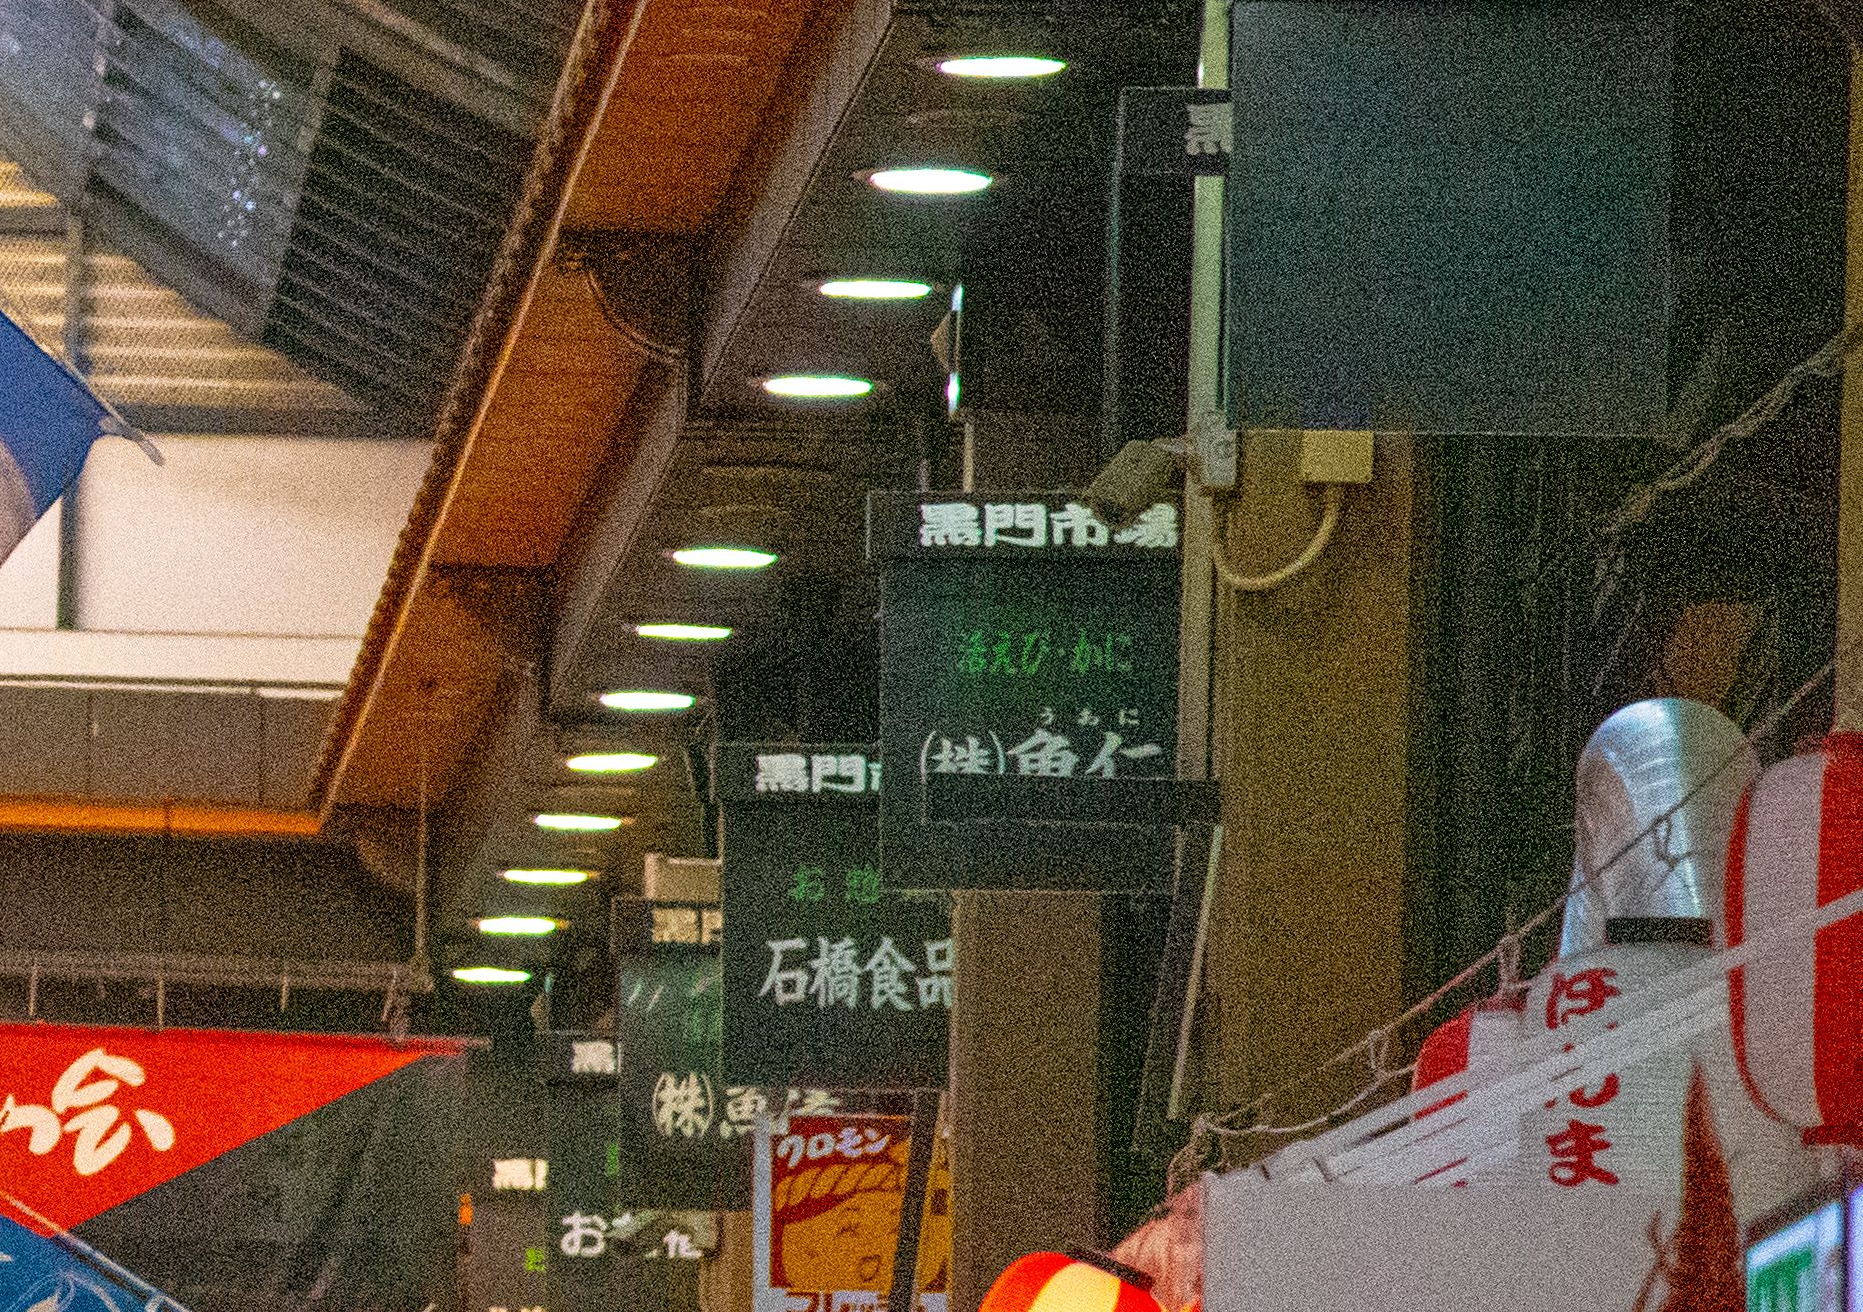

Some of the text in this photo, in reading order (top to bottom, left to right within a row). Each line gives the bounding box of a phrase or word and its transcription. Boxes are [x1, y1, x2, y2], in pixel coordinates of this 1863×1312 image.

[918, 502, 1175, 547] 黒門市場
[755, 753, 882, 794] 黒門
[759, 937, 956, 1012] 石橋食品
[776, 1128, 893, 1169] クロモン
